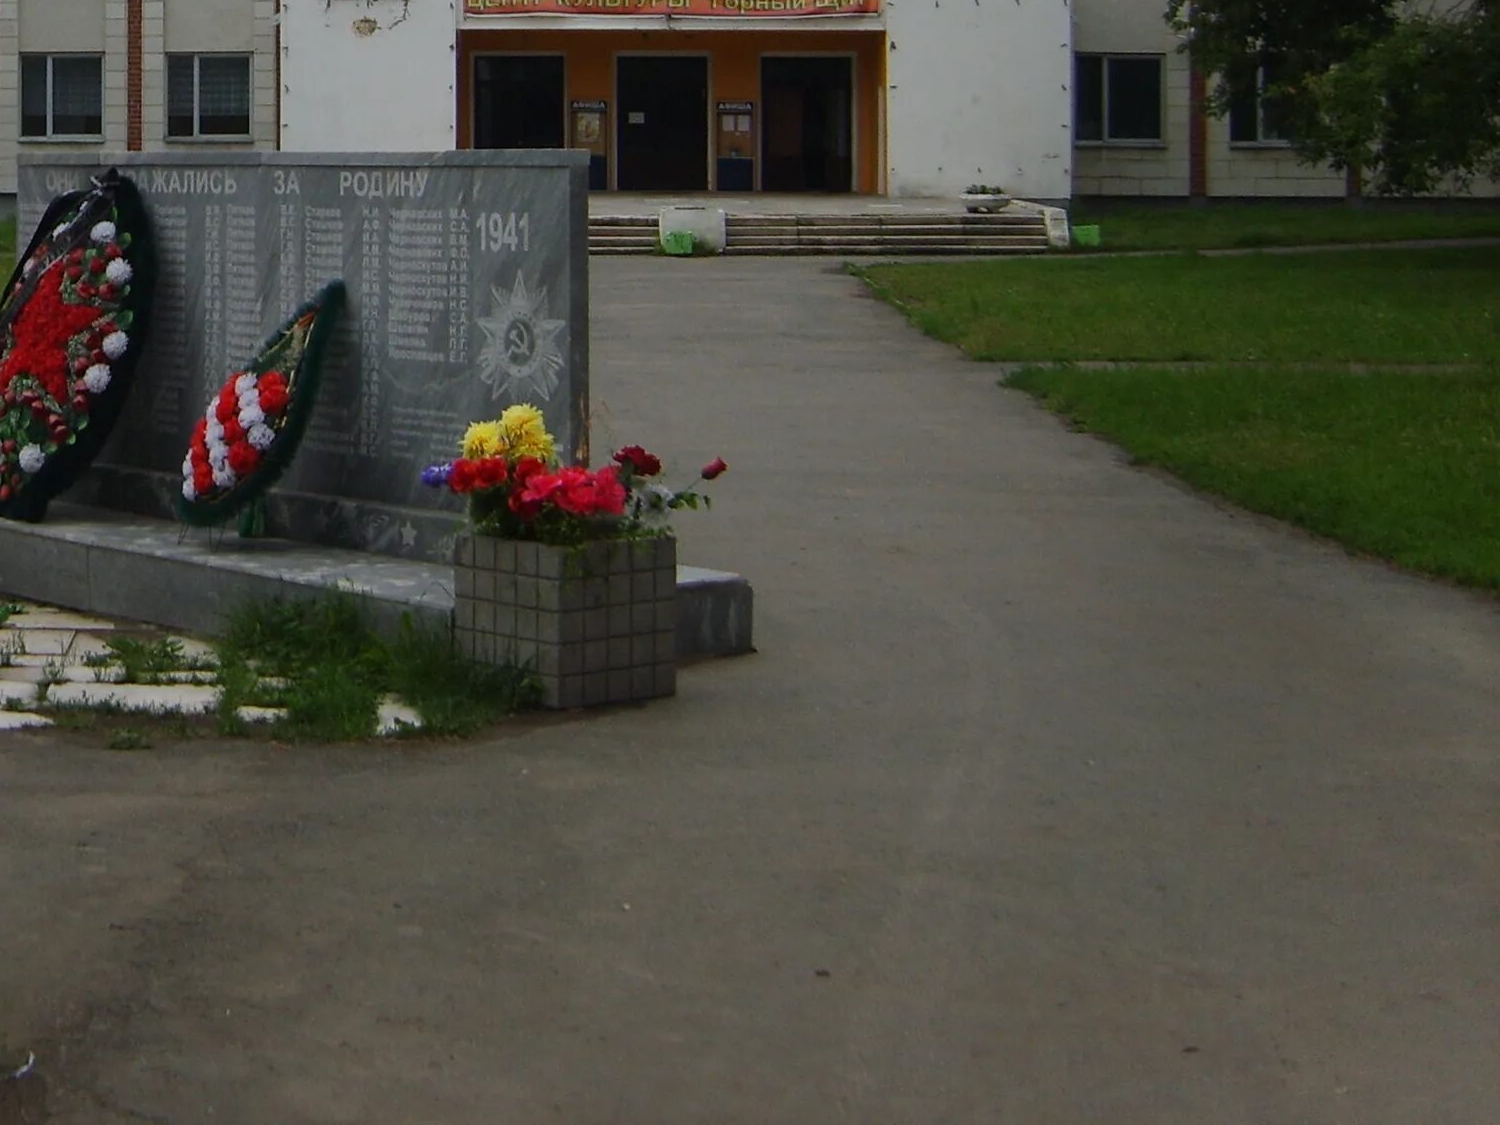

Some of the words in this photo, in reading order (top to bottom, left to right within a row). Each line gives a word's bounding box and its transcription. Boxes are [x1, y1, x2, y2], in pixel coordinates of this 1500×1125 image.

[45, 172, 80, 190] ОНИ
[122, 170, 237, 195] АЖАЛИСЬ
[274, 171, 300, 195] ЗА
[339, 171, 429, 198] РОДИНУ
[476, 212, 530, 252] 1941
